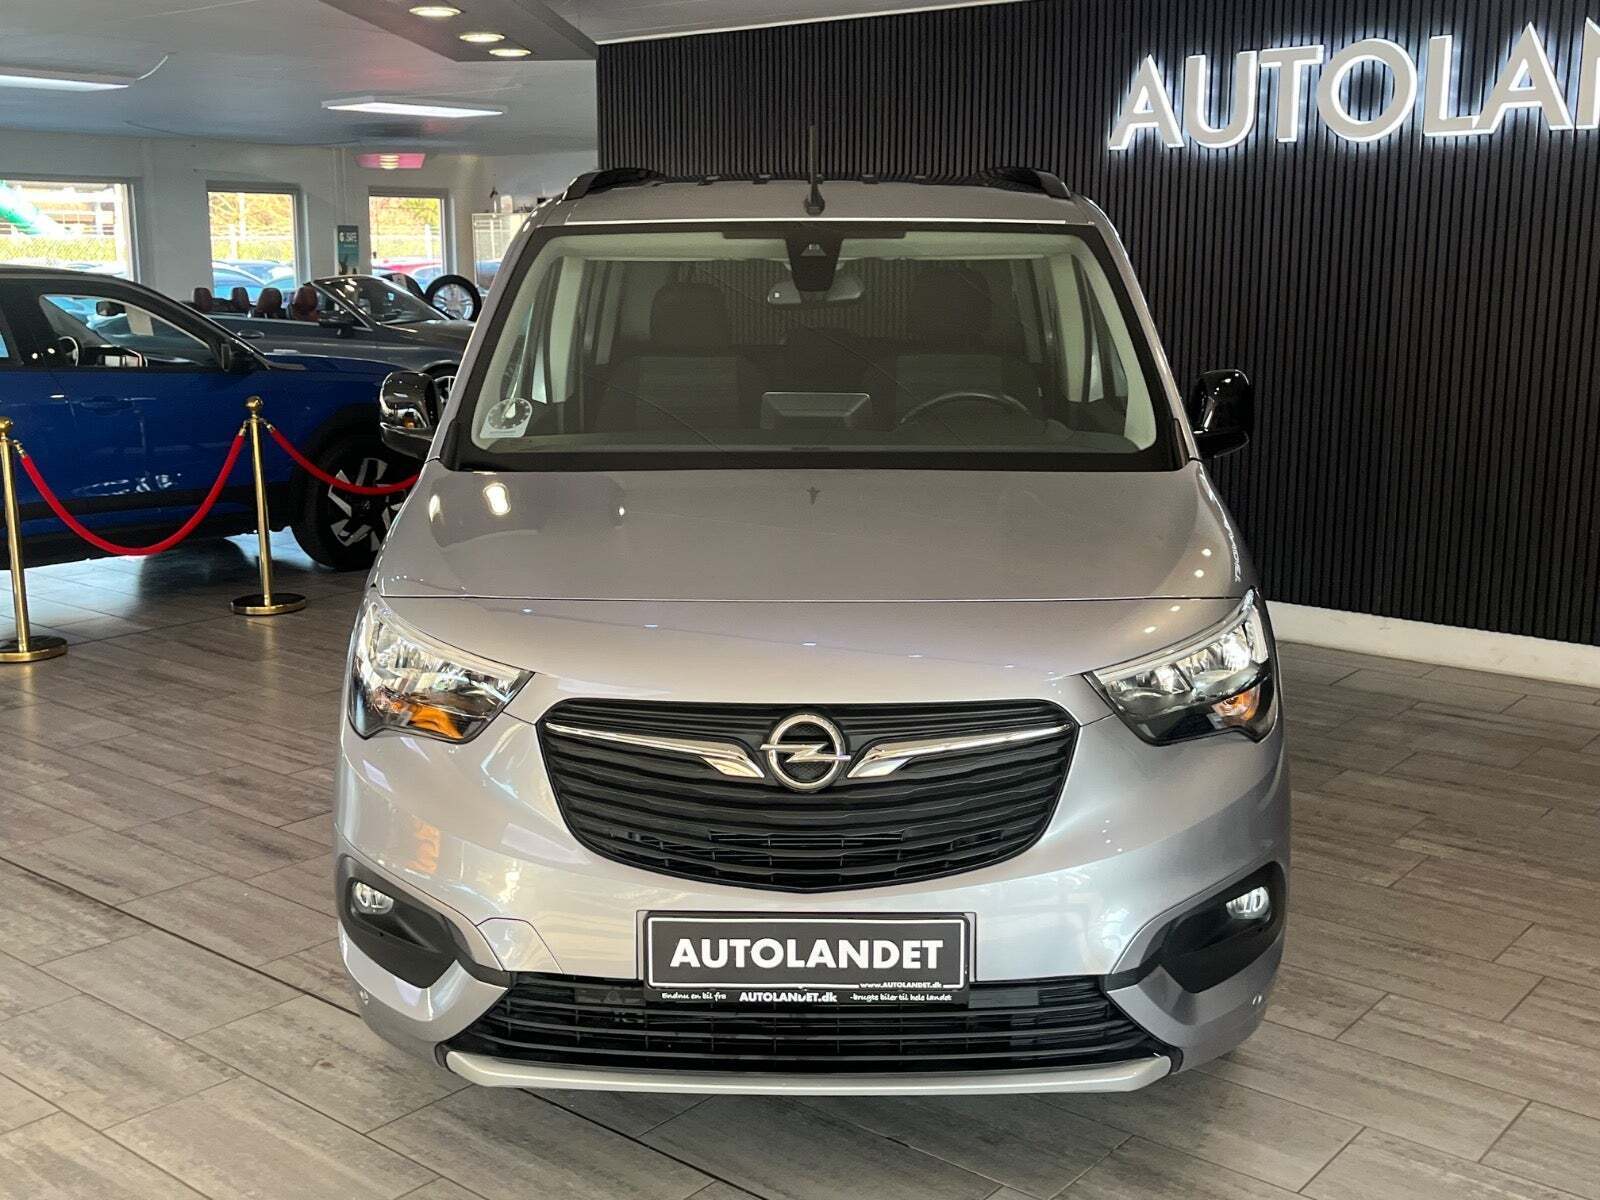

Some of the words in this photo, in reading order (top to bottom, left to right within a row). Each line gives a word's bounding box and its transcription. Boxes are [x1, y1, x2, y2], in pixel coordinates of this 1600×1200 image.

[669, 938, 944, 969] AUTOLANDET
[859, 981, 942, 989] www.AUTOLANDET.dk
[661, 991, 690, 999] Endnu
[702, 991, 713, 1000] bil
[713, 991, 727, 1002] fra
[879, 993, 898, 1001] biler
[898, 993, 909, 1001] til
[910, 993, 925, 1001] hele
[925, 993, 952, 1001] landet
